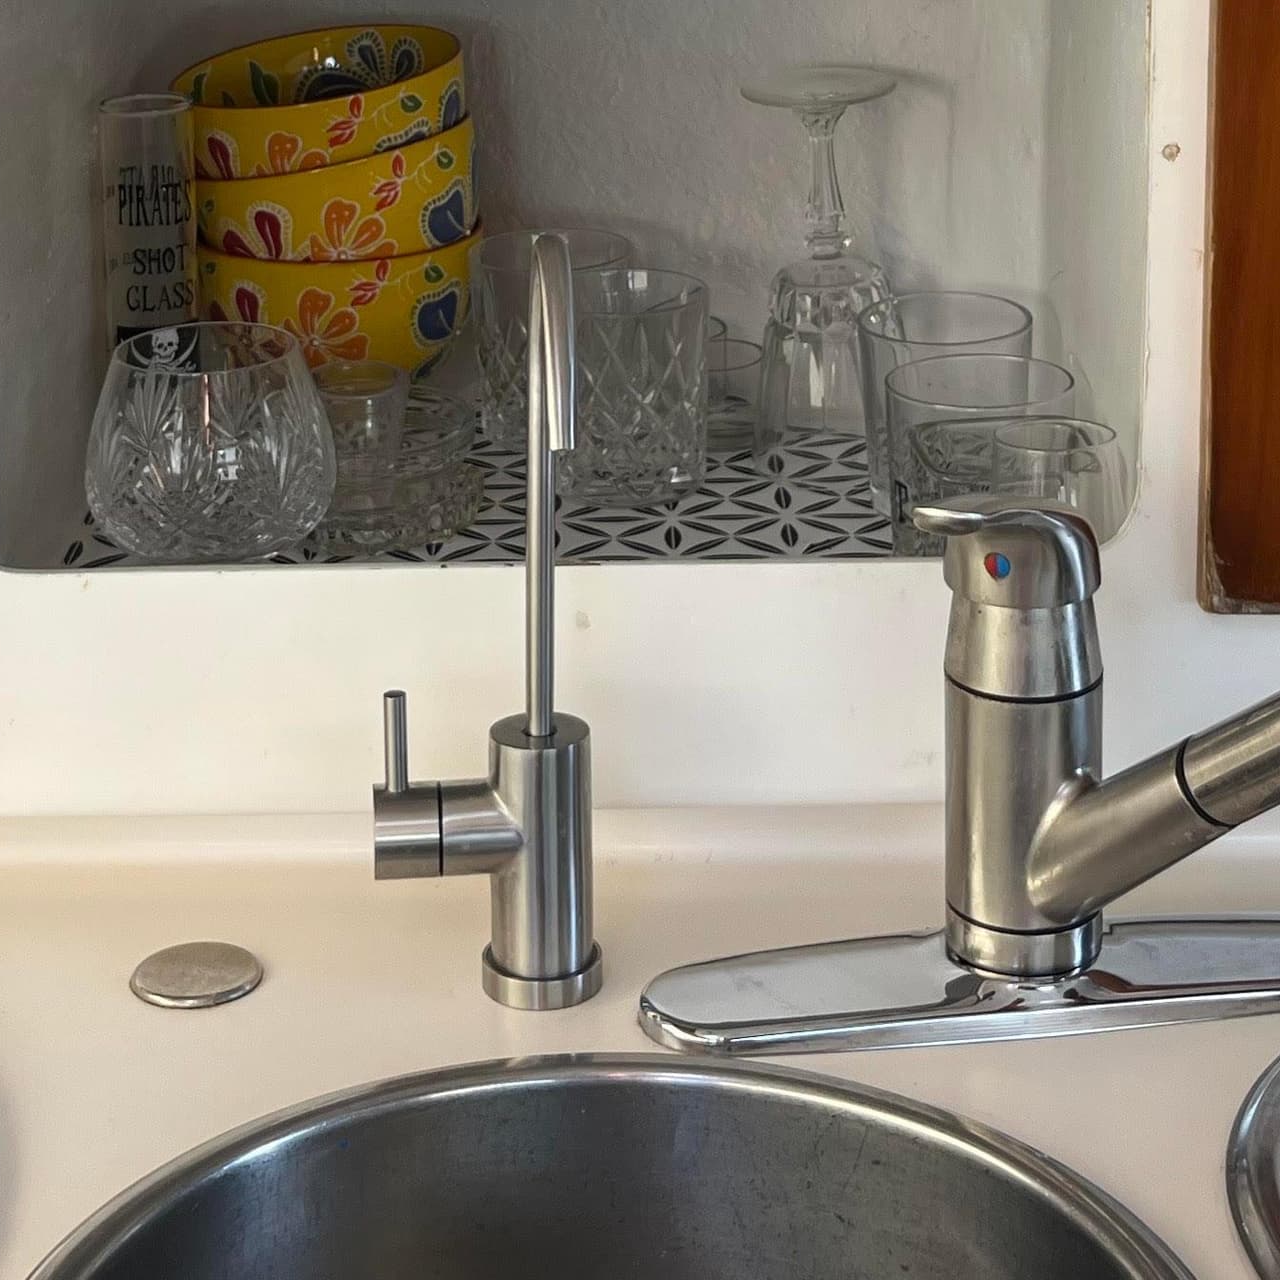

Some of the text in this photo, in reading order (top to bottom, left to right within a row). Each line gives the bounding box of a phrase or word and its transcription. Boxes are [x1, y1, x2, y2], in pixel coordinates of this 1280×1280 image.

[117, 179, 192, 227] PIRATES
[132, 243, 189, 275] SHOT
[125, 279, 194, 313] GLASS
